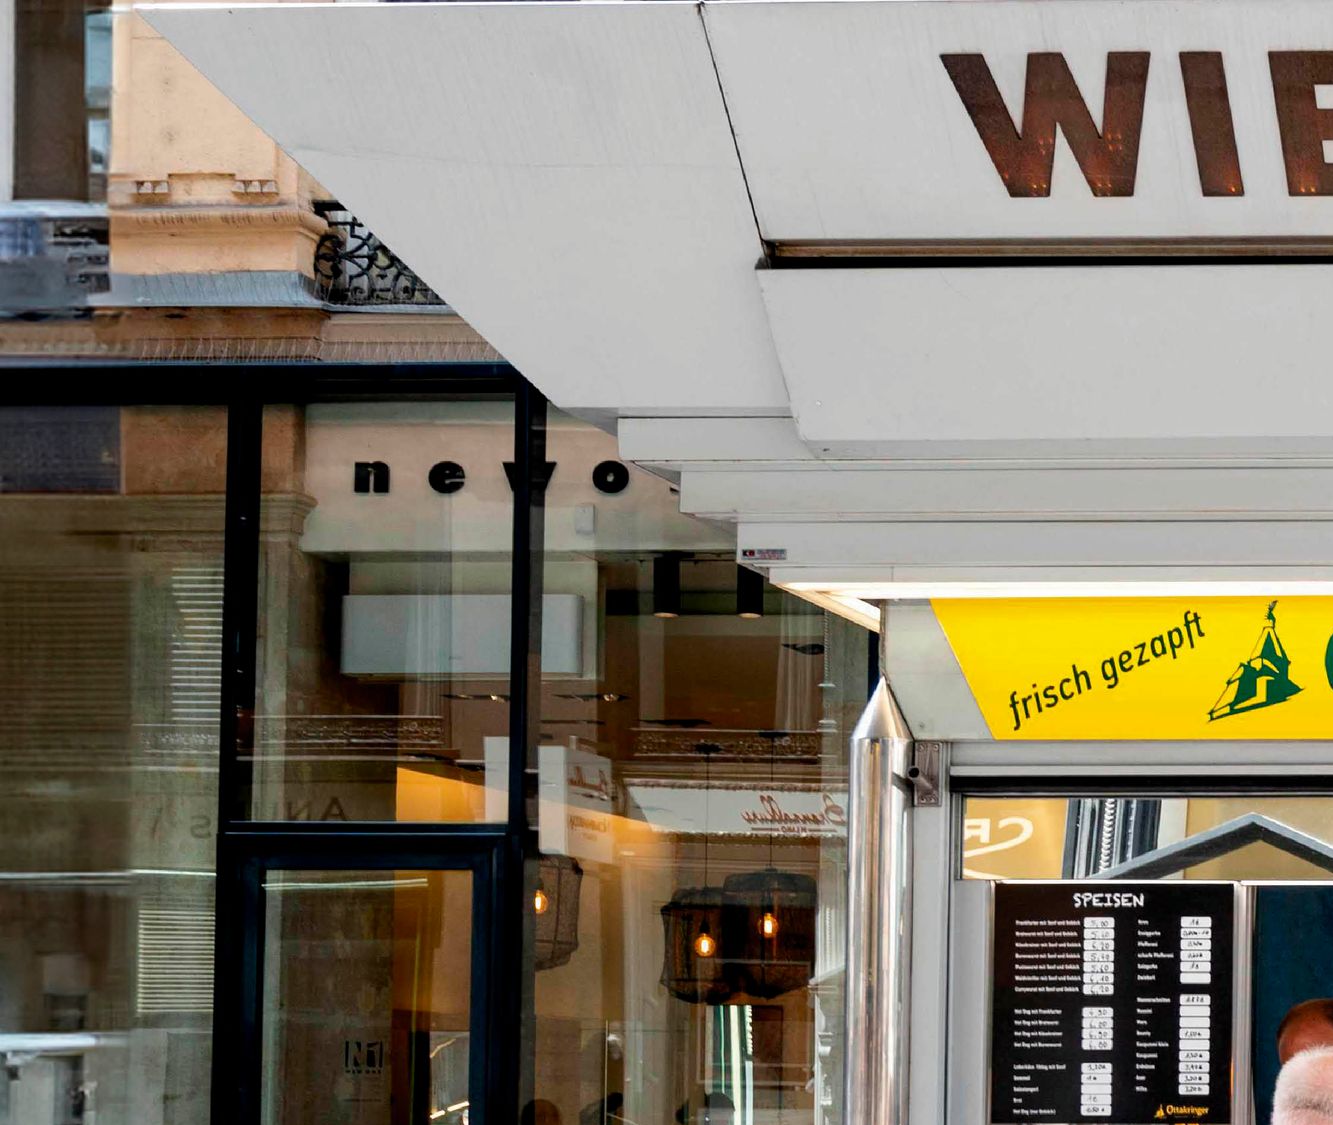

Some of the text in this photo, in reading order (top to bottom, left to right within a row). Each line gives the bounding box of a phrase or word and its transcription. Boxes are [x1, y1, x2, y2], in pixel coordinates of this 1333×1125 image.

[1009, 610, 1205, 731] frisch gezapft
[1073, 893, 1145, 908] SPEISEN
